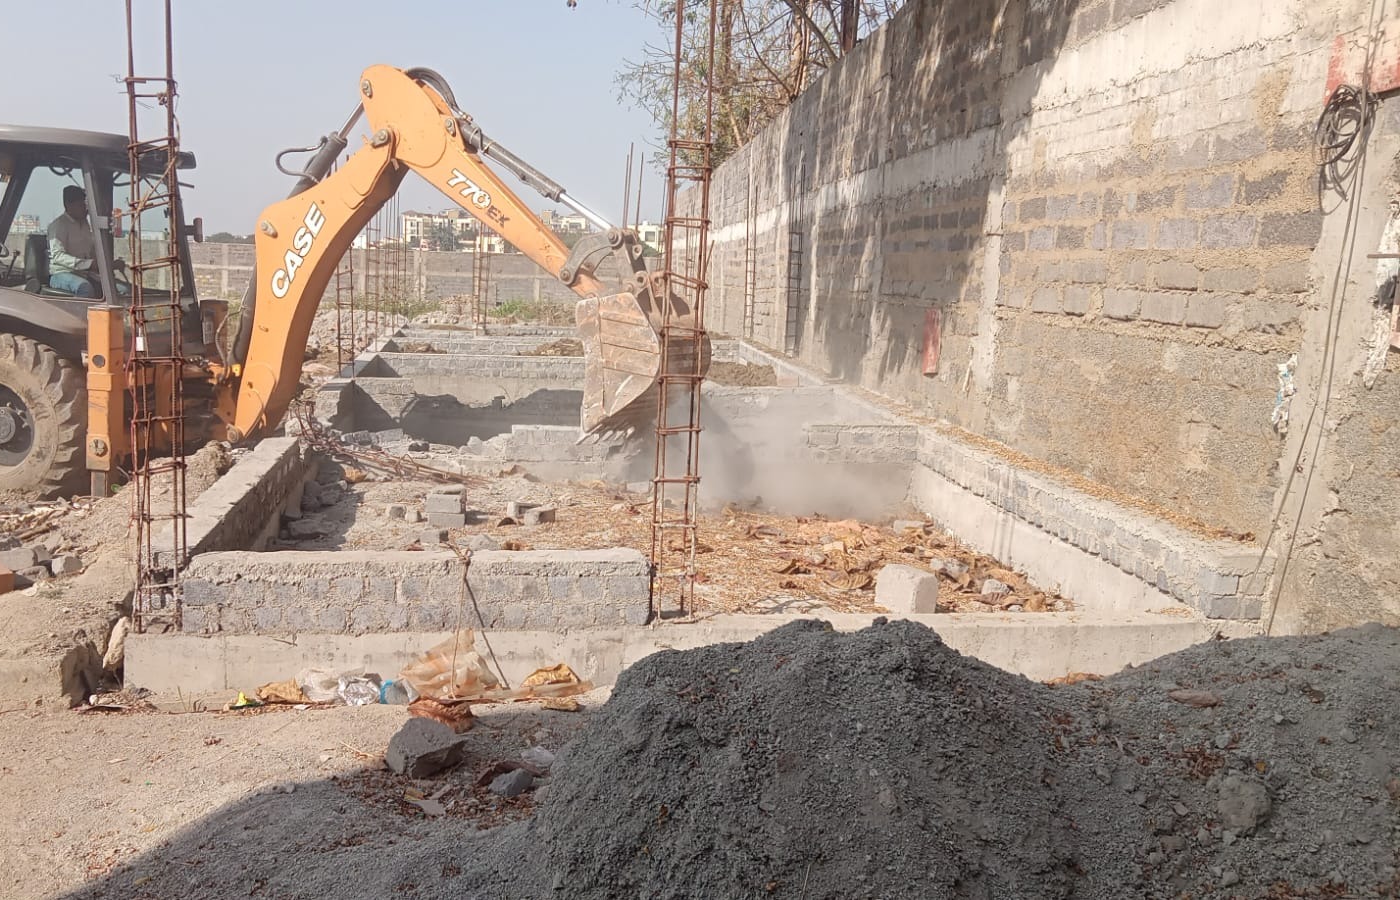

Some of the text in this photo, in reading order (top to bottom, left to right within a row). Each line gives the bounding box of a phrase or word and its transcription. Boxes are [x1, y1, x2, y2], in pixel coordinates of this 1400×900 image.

[447, 167, 510, 228] 770 EX
[271, 201, 326, 299] CASE
